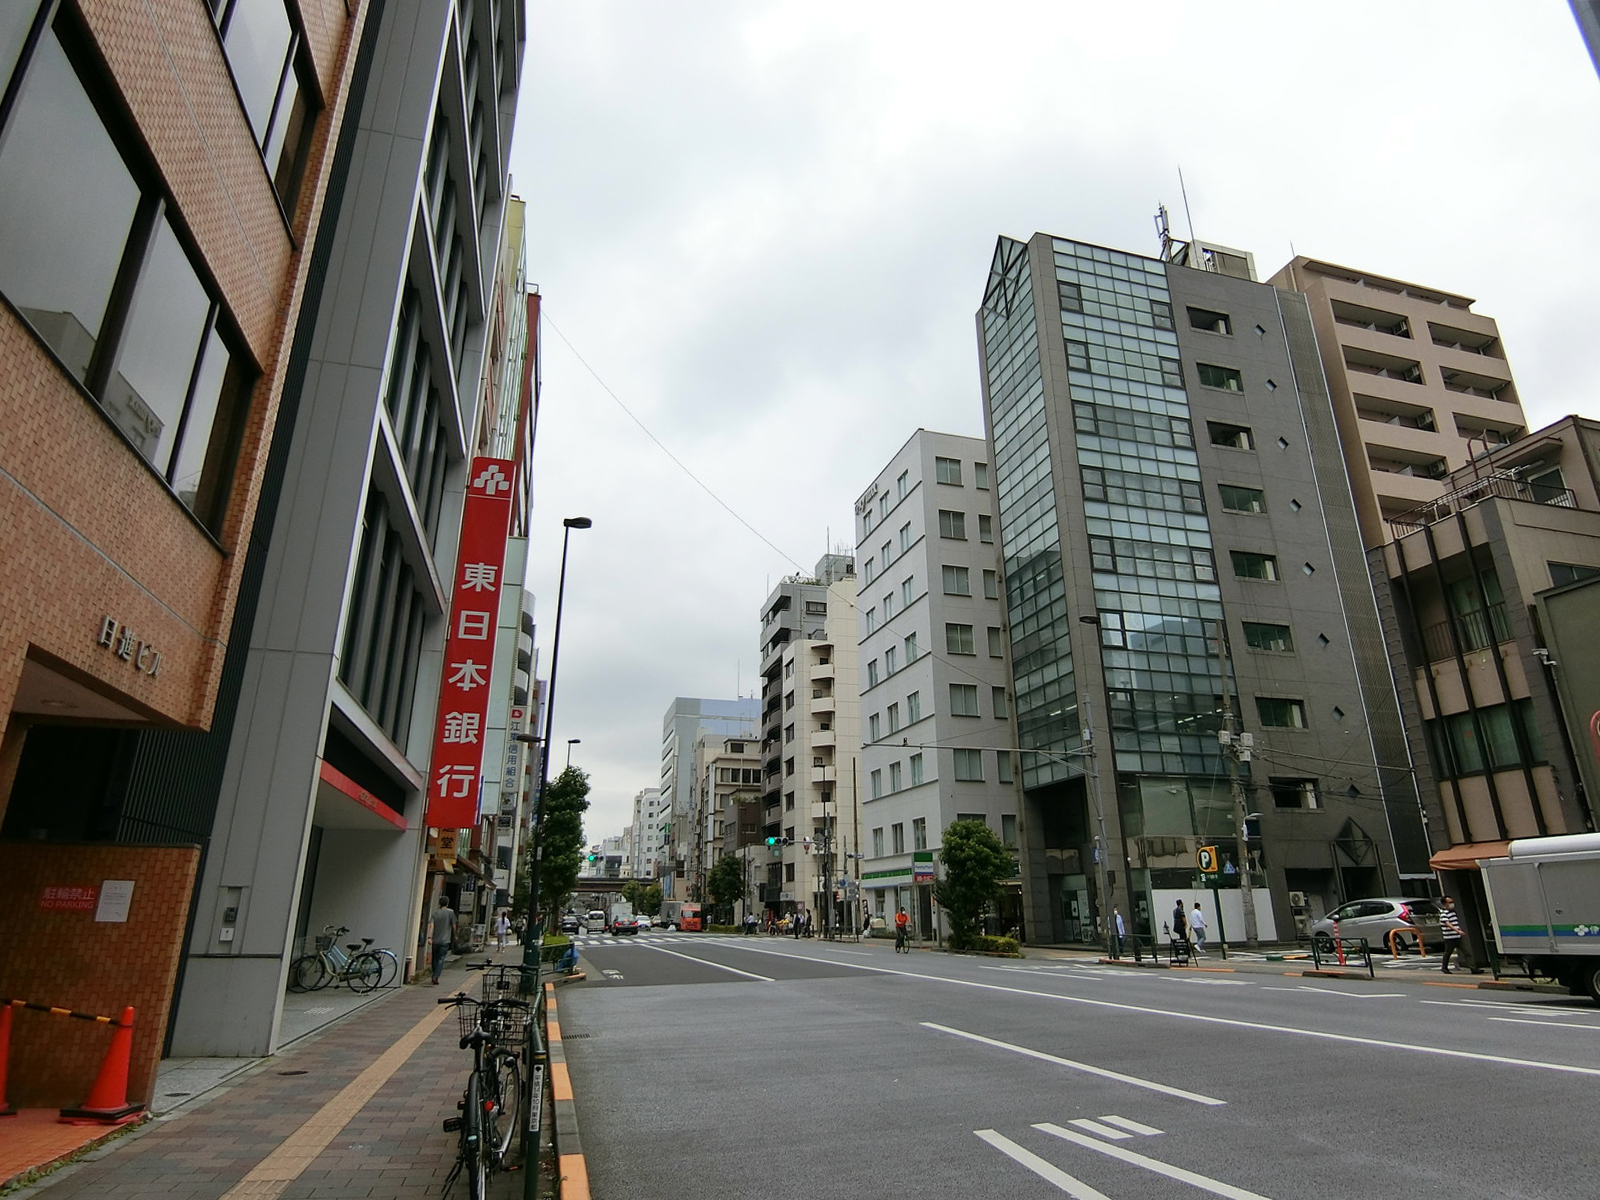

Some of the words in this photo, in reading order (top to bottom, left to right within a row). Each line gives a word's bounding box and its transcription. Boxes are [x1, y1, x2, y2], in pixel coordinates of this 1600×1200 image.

[98, 615, 163, 676] 日進ビル
[437, 562, 499, 799] 東日本銀行
[505, 720, 521, 788] 江東信用組合
[1200, 851, 1209, 868] P
[40, 900, 54, 908] NO
[55, 900, 94, 909] PARKING
[42, 887, 95, 900] 駐輪禁止
